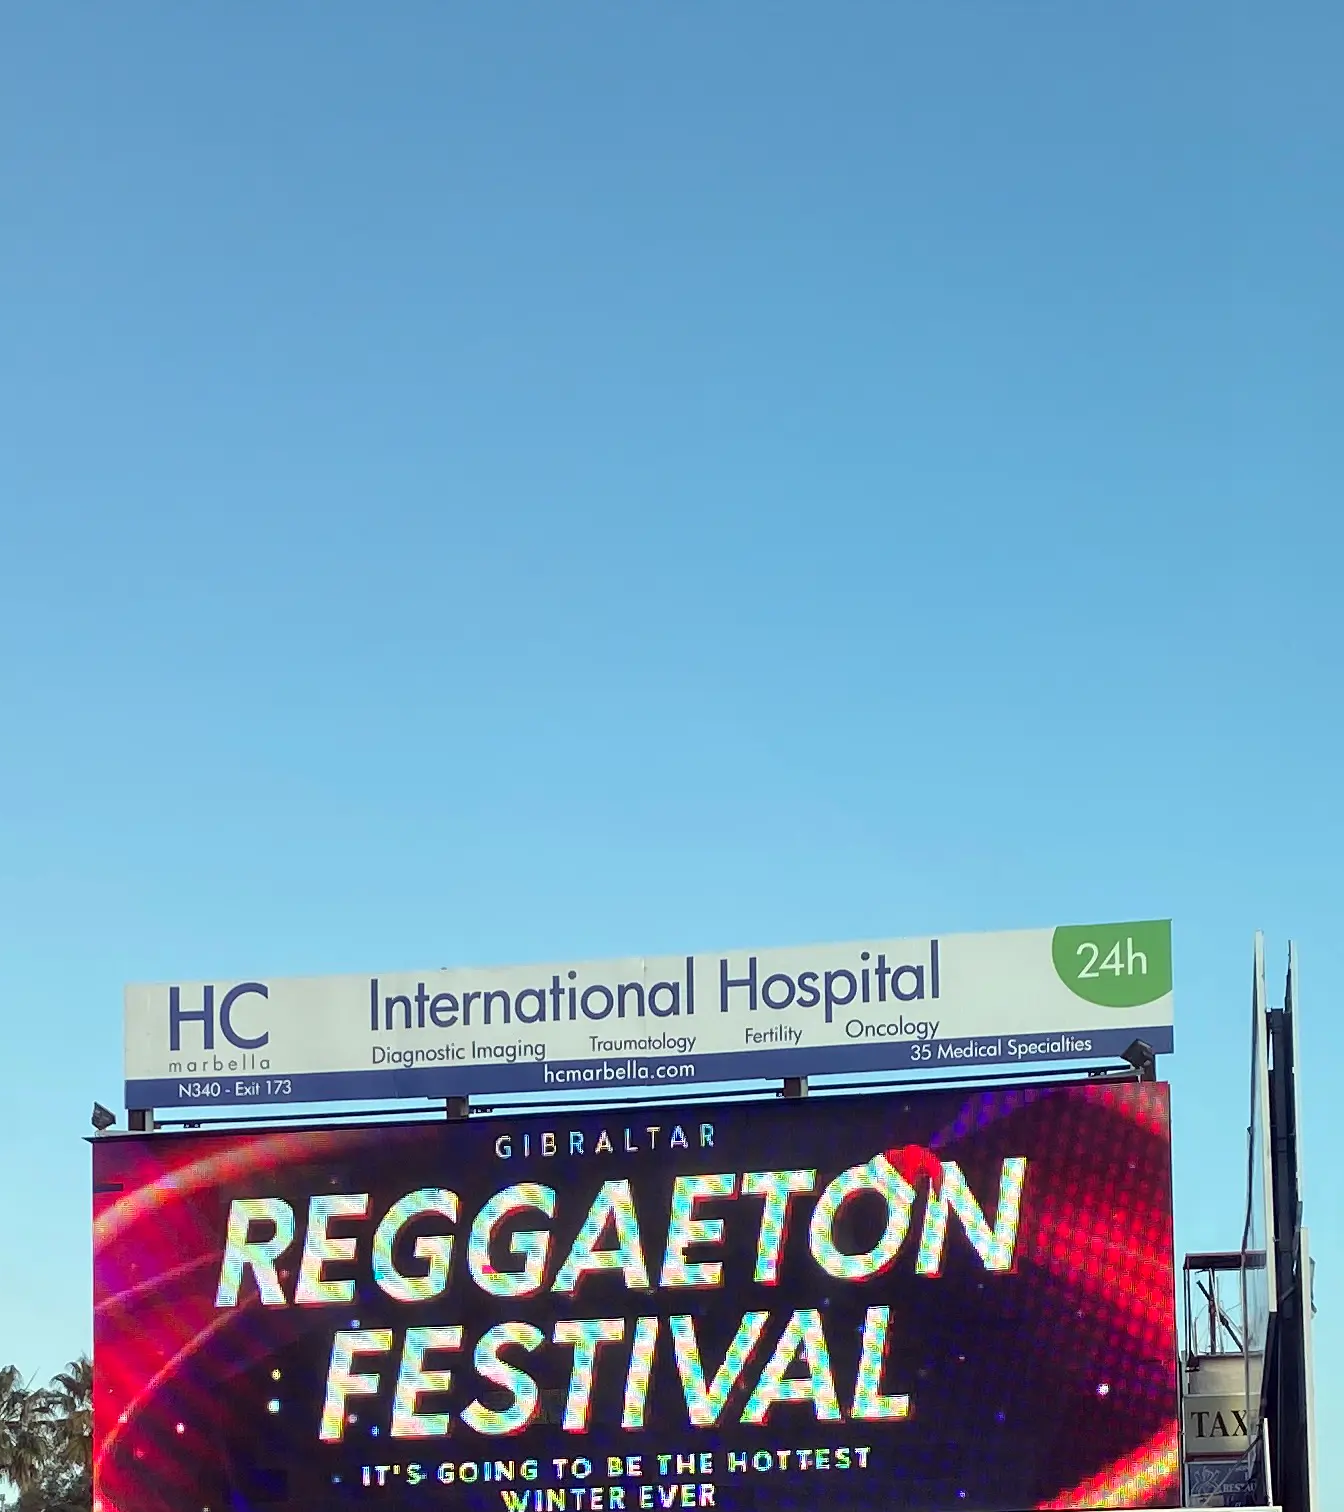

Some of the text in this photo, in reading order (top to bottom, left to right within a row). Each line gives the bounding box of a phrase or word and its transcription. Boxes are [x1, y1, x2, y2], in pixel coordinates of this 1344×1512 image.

[1076, 937, 1147, 979] 24h
[370, 939, 941, 1032] International Hospital
[169, 982, 269, 1051] HC
[845, 1016, 940, 1041] Oncology
[589, 1032, 697, 1053] Traumatology
[745, 1023, 803, 1046] Fertility
[910, 1035, 1092, 1061] 35 Medical Specialties
[168, 1054, 270, 1073] marbella
[372, 1040, 546, 1068] Diagnostic Imaging
[544, 1060, 695, 1084] hcmarbella.com
[178, 1080, 221, 1097] N340
[235, 1079, 260, 1096] Exit
[263, 1079, 292, 1096] 173
[495, 1122, 715, 1160] GIBRALTAR
[215, 1156, 1027, 1308] REGGAETON
[319, 1304, 911, 1443] FESTIVAL
[1191, 1409, 1248, 1438] TAX
[361, 1446, 872, 1488] IT'S GOING TO BE THE HOTTEST
[501, 1482, 716, 1512] WINTER EVER
